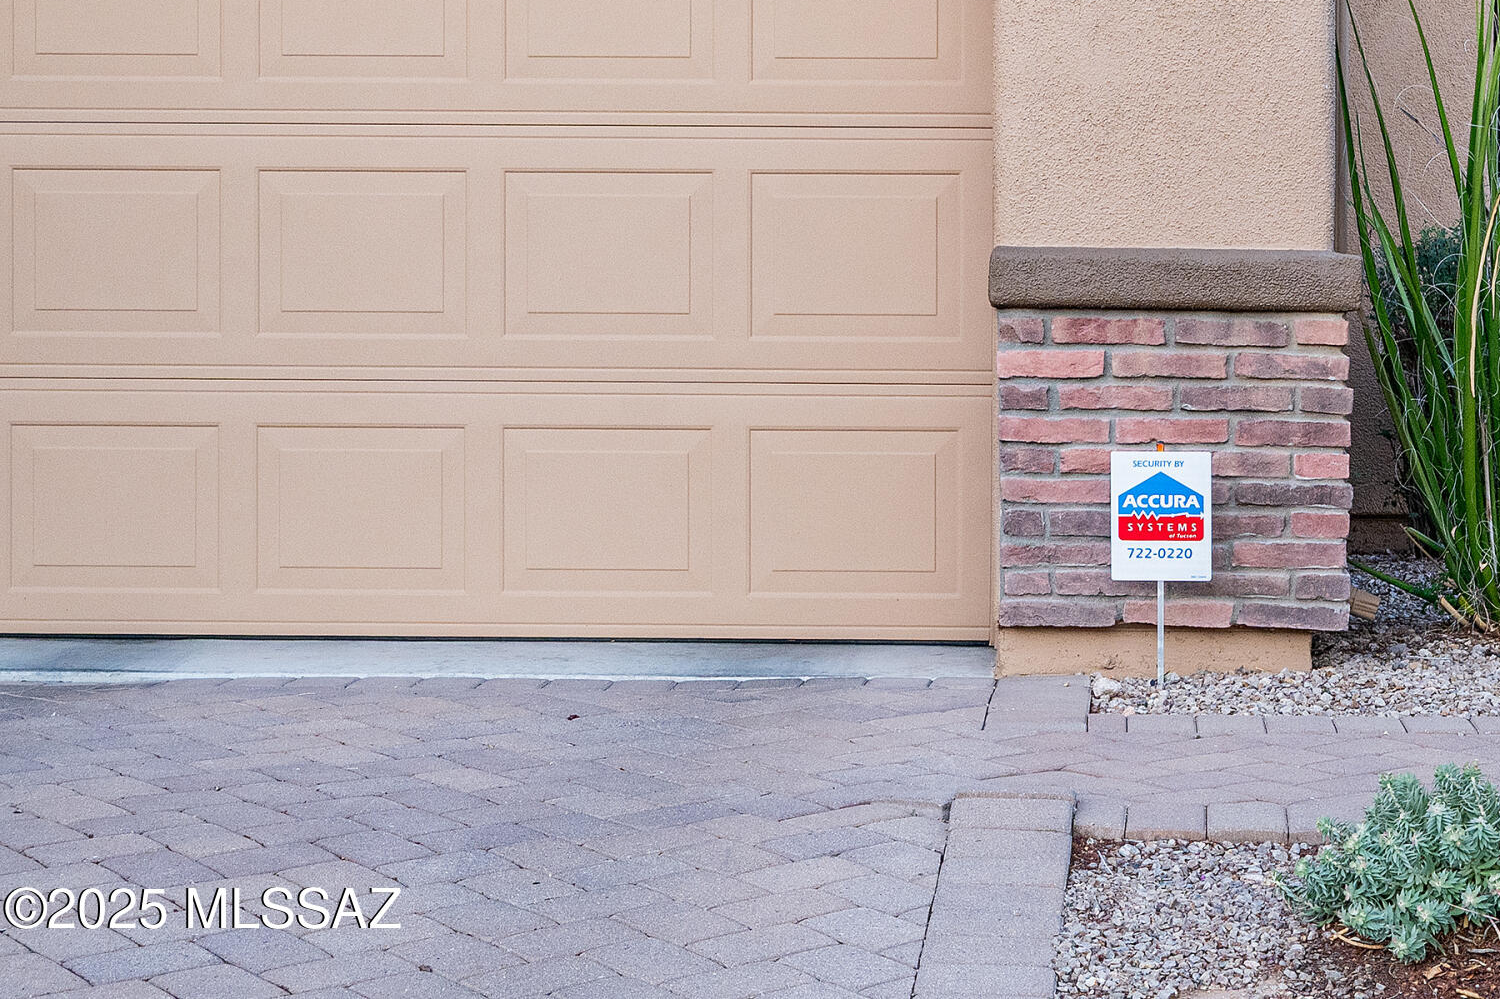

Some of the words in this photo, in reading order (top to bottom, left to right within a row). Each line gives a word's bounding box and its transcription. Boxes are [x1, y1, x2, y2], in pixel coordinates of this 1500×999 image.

[1132, 460, 1172, 468] SECURITY
[1174, 460, 1185, 468] BY
[1122, 494, 1200, 509] ACCURA
[1127, 522, 1197, 532] SYSTEMS
[1127, 547, 1193, 559] 722-0220
